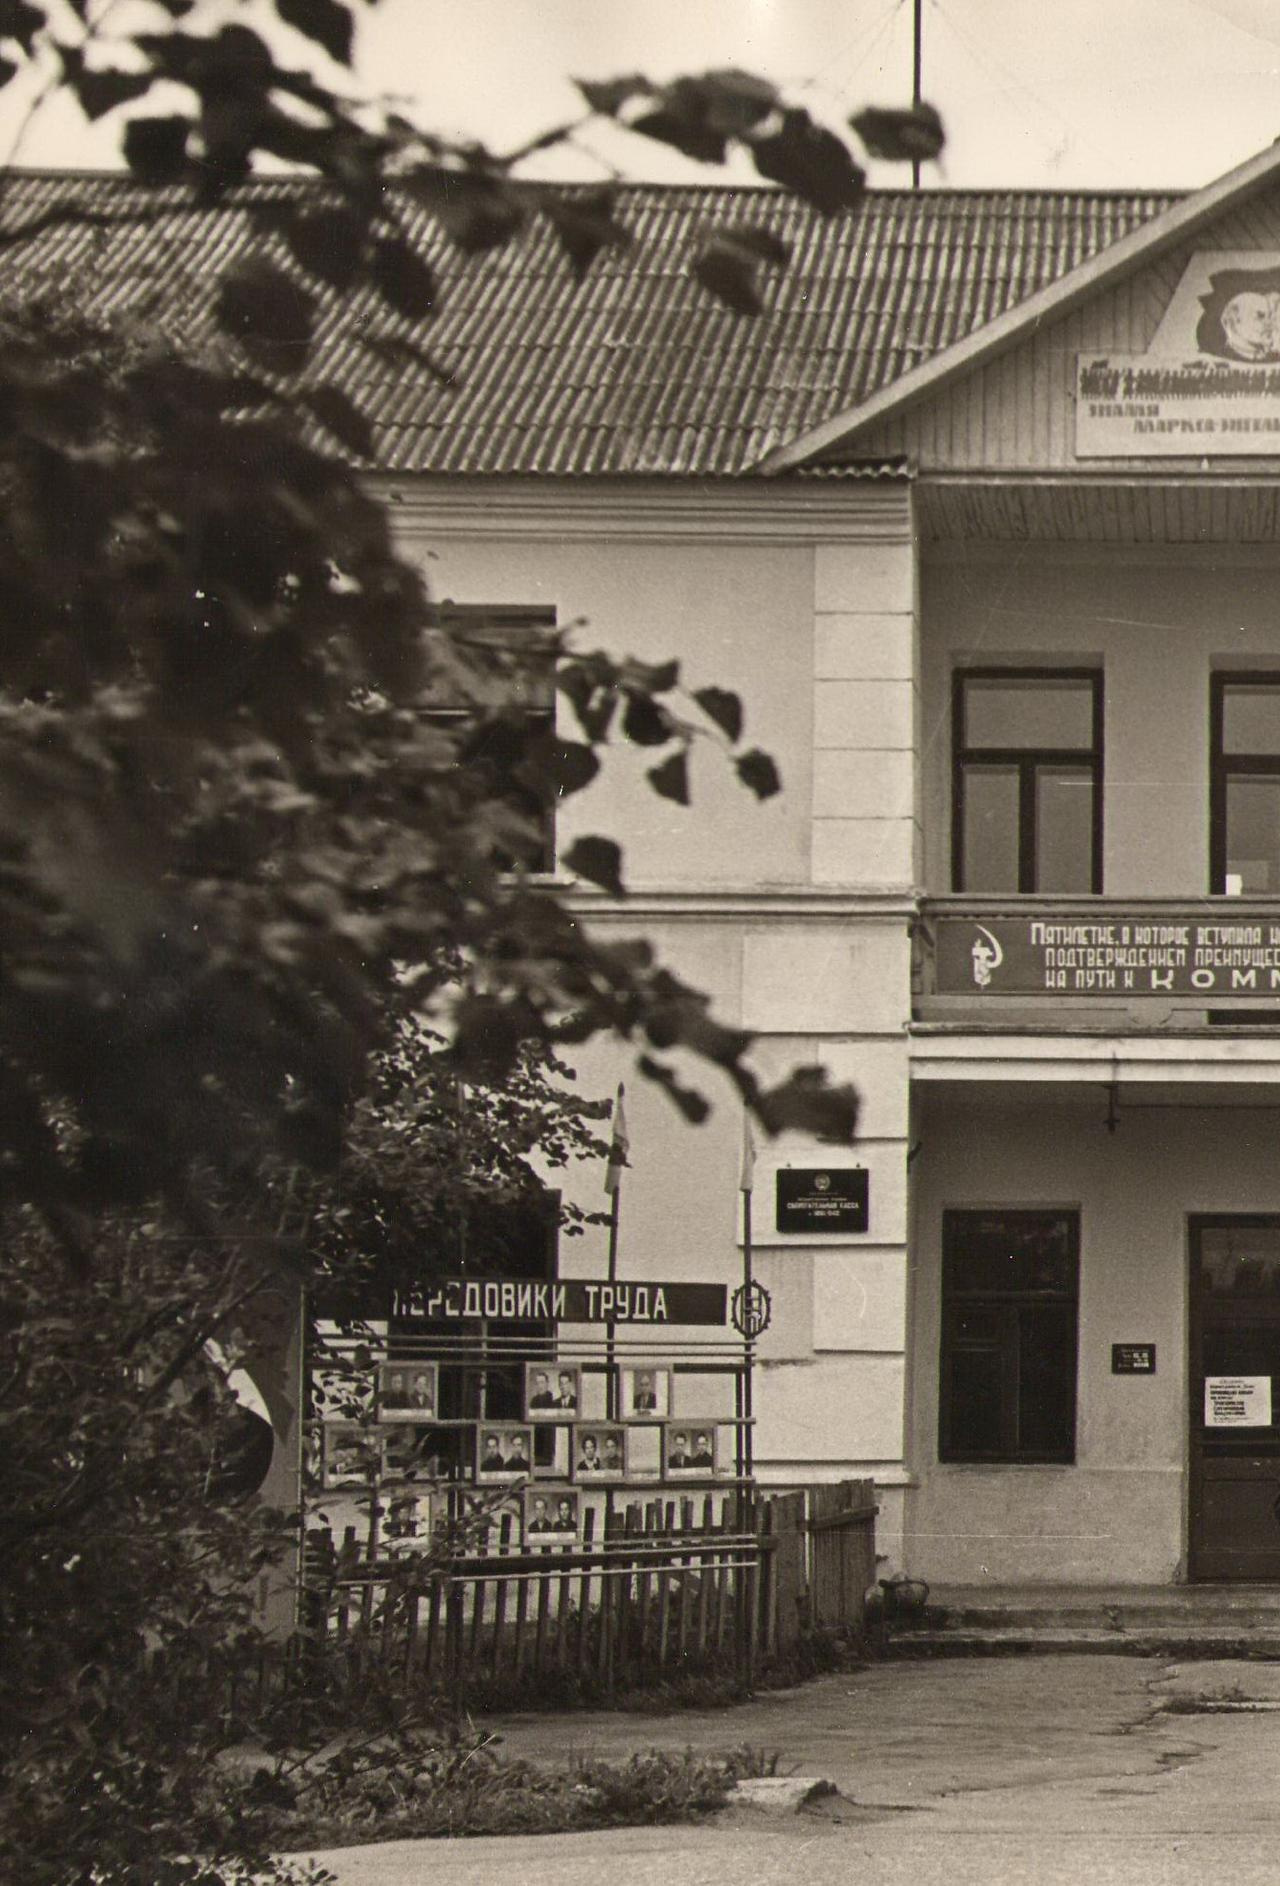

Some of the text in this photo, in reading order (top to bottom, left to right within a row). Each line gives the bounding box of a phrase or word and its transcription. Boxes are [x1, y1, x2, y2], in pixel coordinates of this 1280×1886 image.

[1135, 926, 1190, 945] КОТОРОЕ
[1197, 926, 1262, 945] ВСТУПИЛА
[1046, 948, 1186, 967] ПОДТВЕРЖДЕНИЕМ
[1045, 969, 1067, 988] НА
[1075, 969, 1116, 988] ПУТИ
[1124, 969, 1134, 988] К
[585, 1284, 669, 1320] ТРУДА
